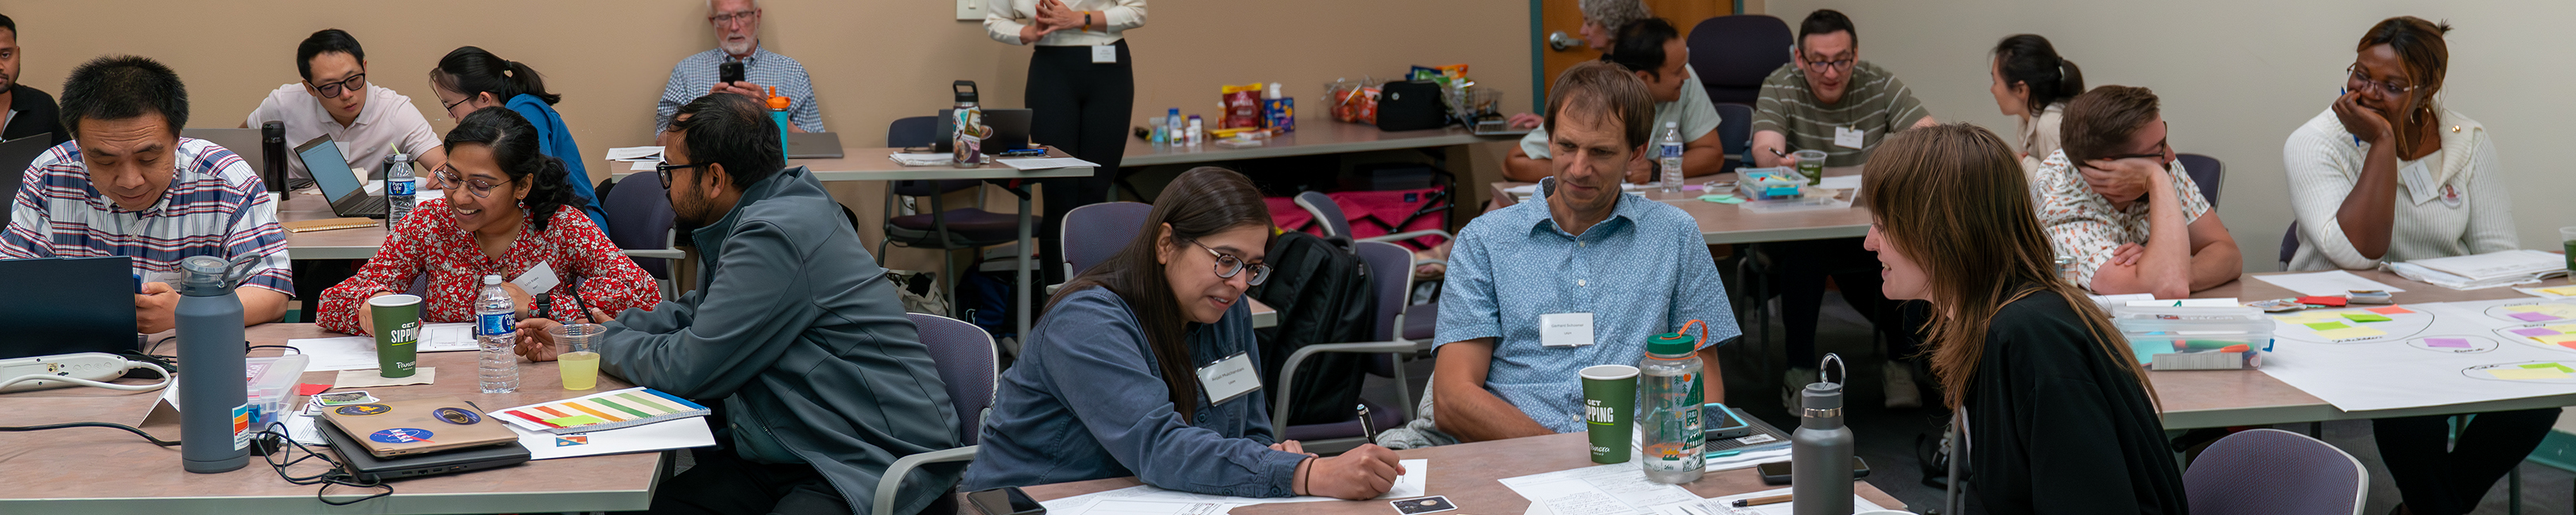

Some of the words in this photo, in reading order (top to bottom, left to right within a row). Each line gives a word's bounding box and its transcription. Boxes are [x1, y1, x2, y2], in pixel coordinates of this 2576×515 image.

[391, 326, 418, 343] SIPPIN
[1585, 405, 1614, 423] IPPING
[1687, 410, 1697, 419] REI
